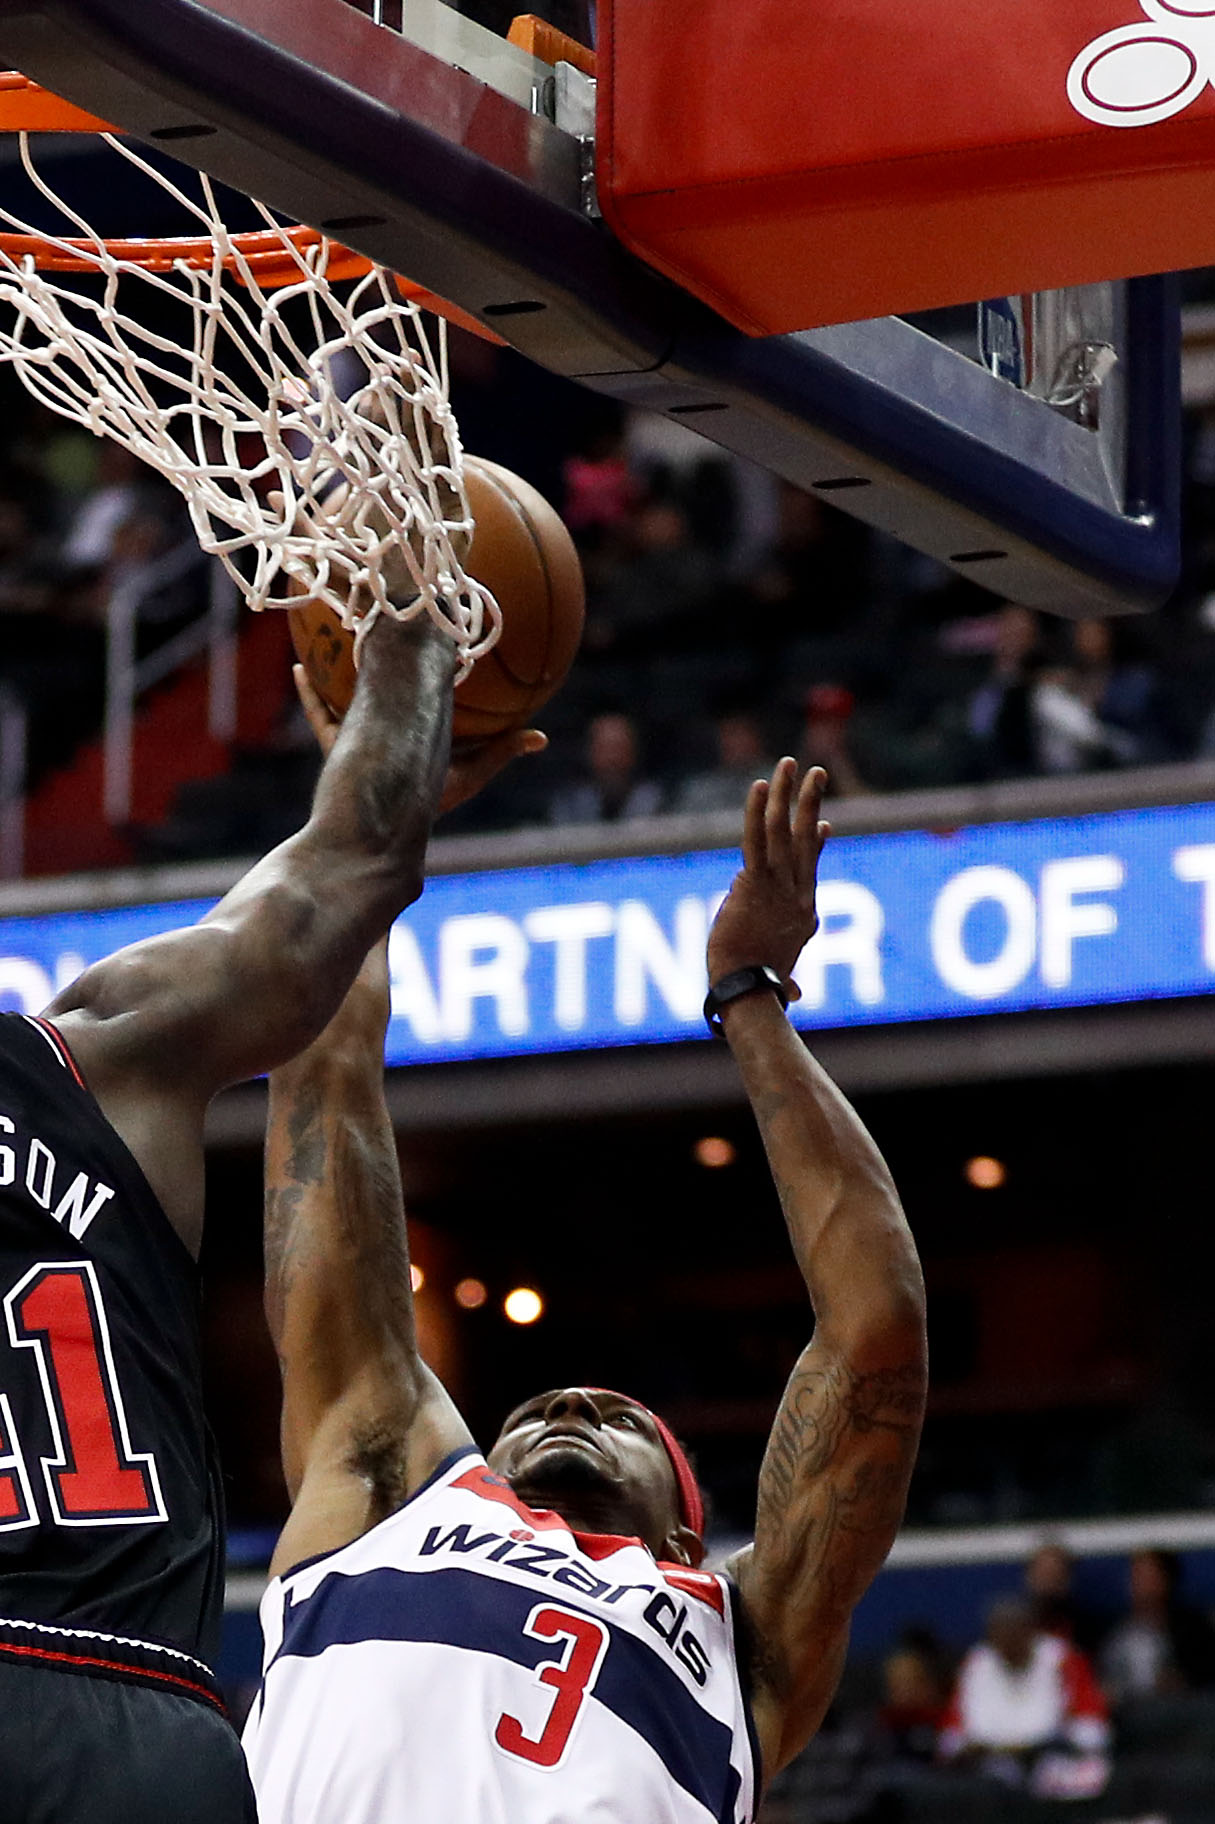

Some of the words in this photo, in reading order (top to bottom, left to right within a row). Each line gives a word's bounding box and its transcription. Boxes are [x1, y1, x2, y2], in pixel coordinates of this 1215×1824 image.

[387, 879, 885, 1044] ARTNR
[929, 854, 1125, 1000] OF
[418, 1523, 713, 1688] wizards
[494, 1602, 610, 1773] 3
